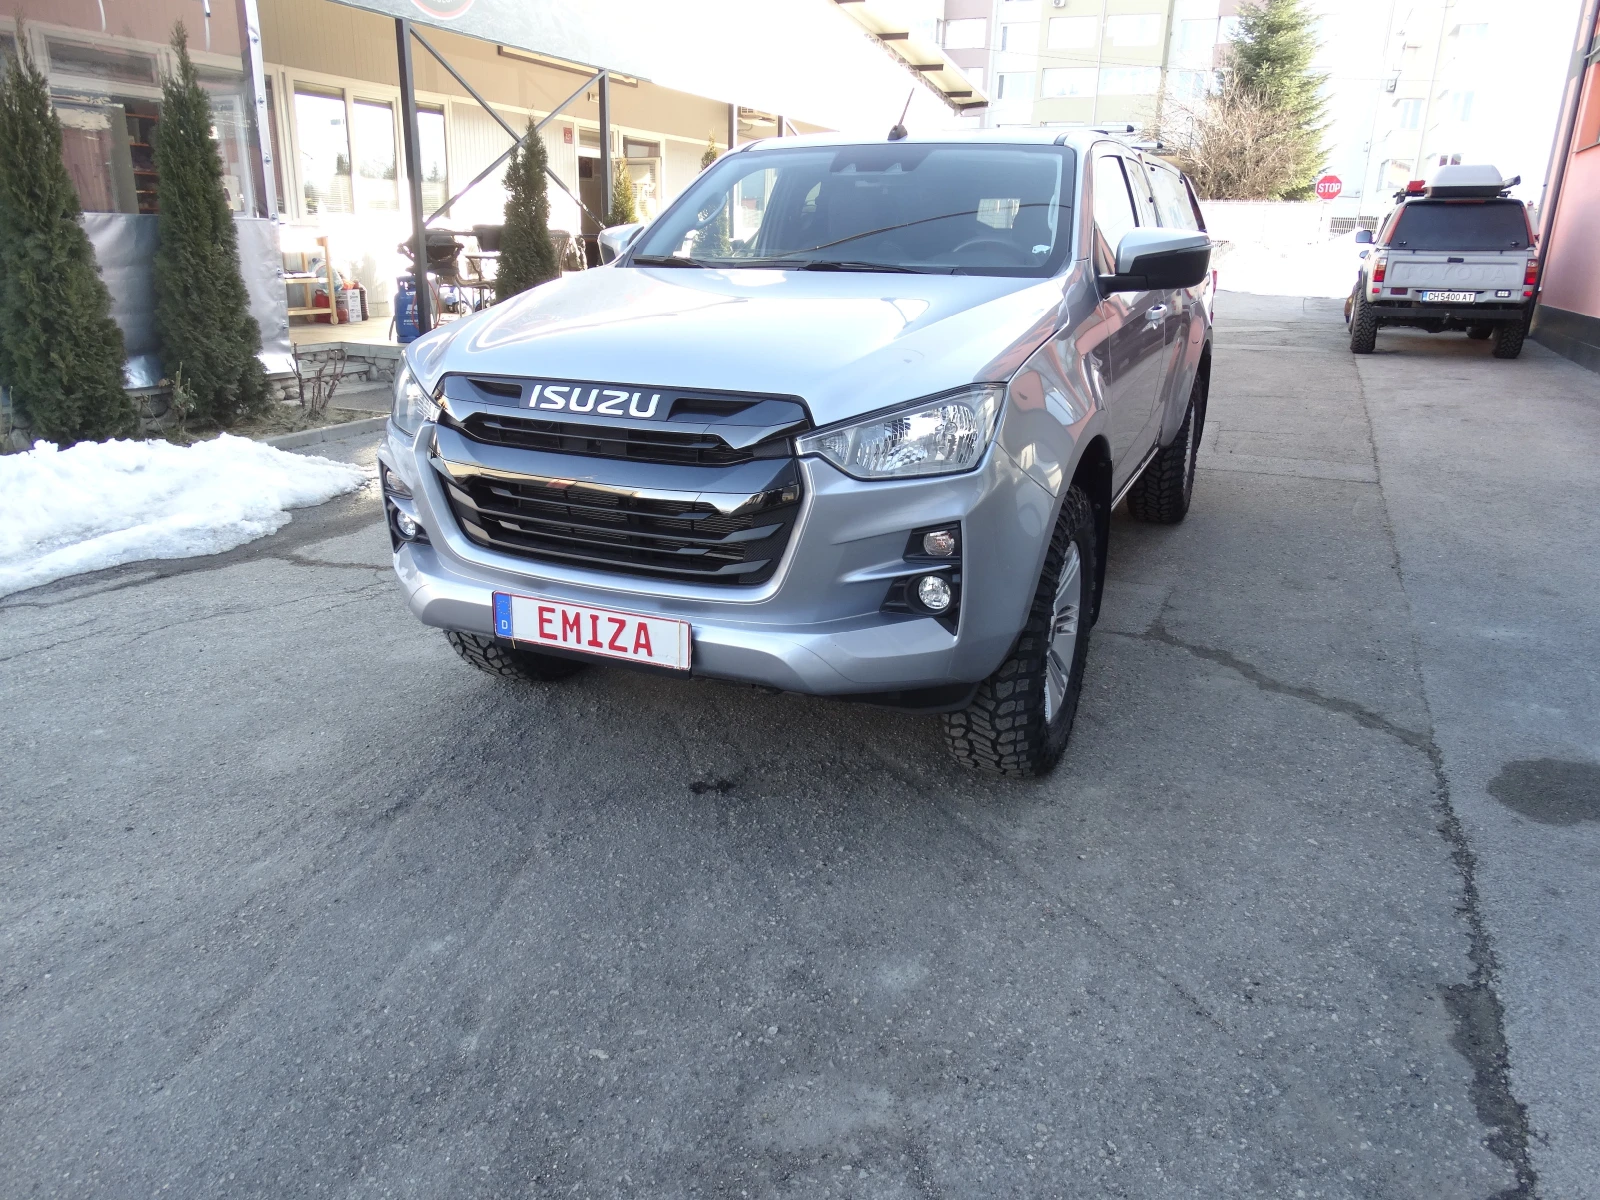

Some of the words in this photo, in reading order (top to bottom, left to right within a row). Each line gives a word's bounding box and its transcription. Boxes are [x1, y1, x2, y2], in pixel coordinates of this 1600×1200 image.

[1318, 182, 1341, 193] STOP
[1401, 264, 1507, 282] TOYOTA
[528, 384, 661, 418] ISUZU
[501, 619, 509, 630] D
[538, 605, 653, 658] EMIZA
